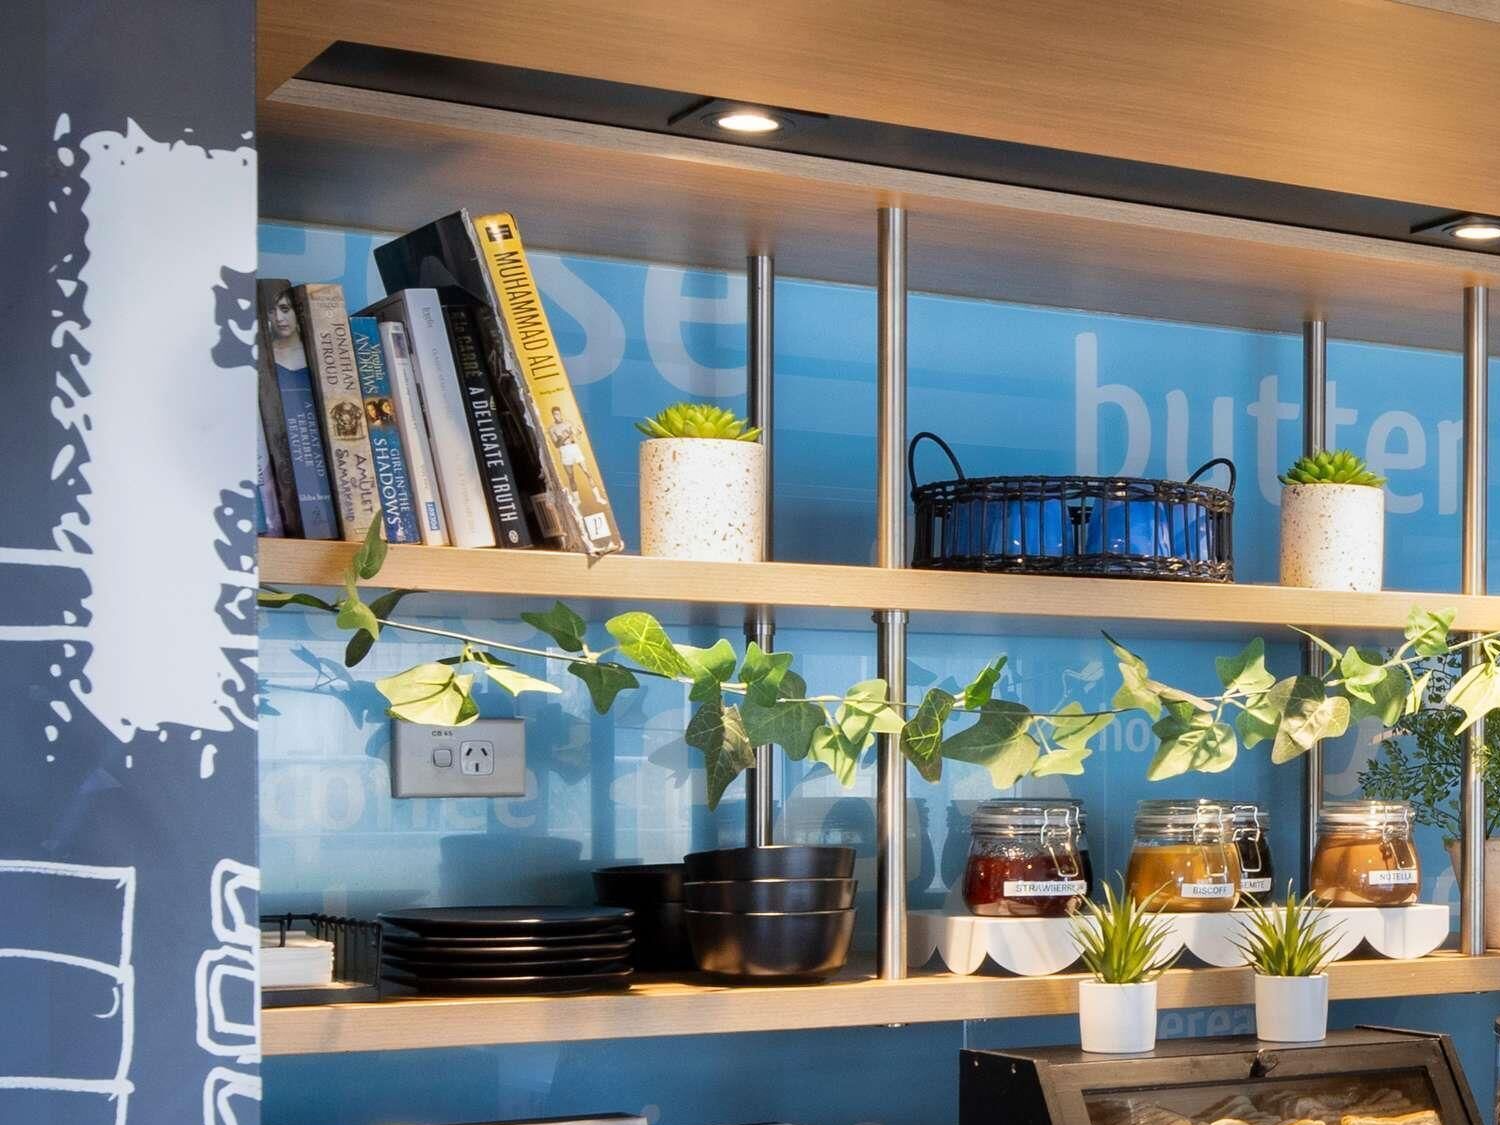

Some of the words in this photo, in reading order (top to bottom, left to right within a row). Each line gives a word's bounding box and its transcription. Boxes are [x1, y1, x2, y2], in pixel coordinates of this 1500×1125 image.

[494, 251, 550, 351] MUHAMMAD
[528, 355, 560, 381] ALI
[321, 333, 340, 385] STROUD
[332, 323, 356, 390] JONATHAN
[354, 332, 378, 394] ANDREWS
[371, 343, 386, 382] Virginia
[305, 401, 313, 409] A
[468, 387, 485, 395] A
[287, 418, 304, 462] BEAUTY
[298, 414, 314, 467] TERRIBLE
[306, 412, 320, 449] GREAT
[472, 400, 505, 468] DELICATE
[1076, 333, 1462, 514] butter
[314, 452, 325, 477] AND
[354, 453, 373, 513] AMULET
[374, 438, 402, 525] SHADOWS
[391, 449, 402, 474] GIRL
[396, 476, 405, 488] IN
[335, 448, 355, 521] SAMARKAND
[399, 489, 410, 512] THE
[491, 474, 518, 522] TRUTH
[1193, 886, 1227, 895] BISCOFF
[1244, 880, 1265, 889] EMITE
[1160, 1003, 1252, 1038] erea
